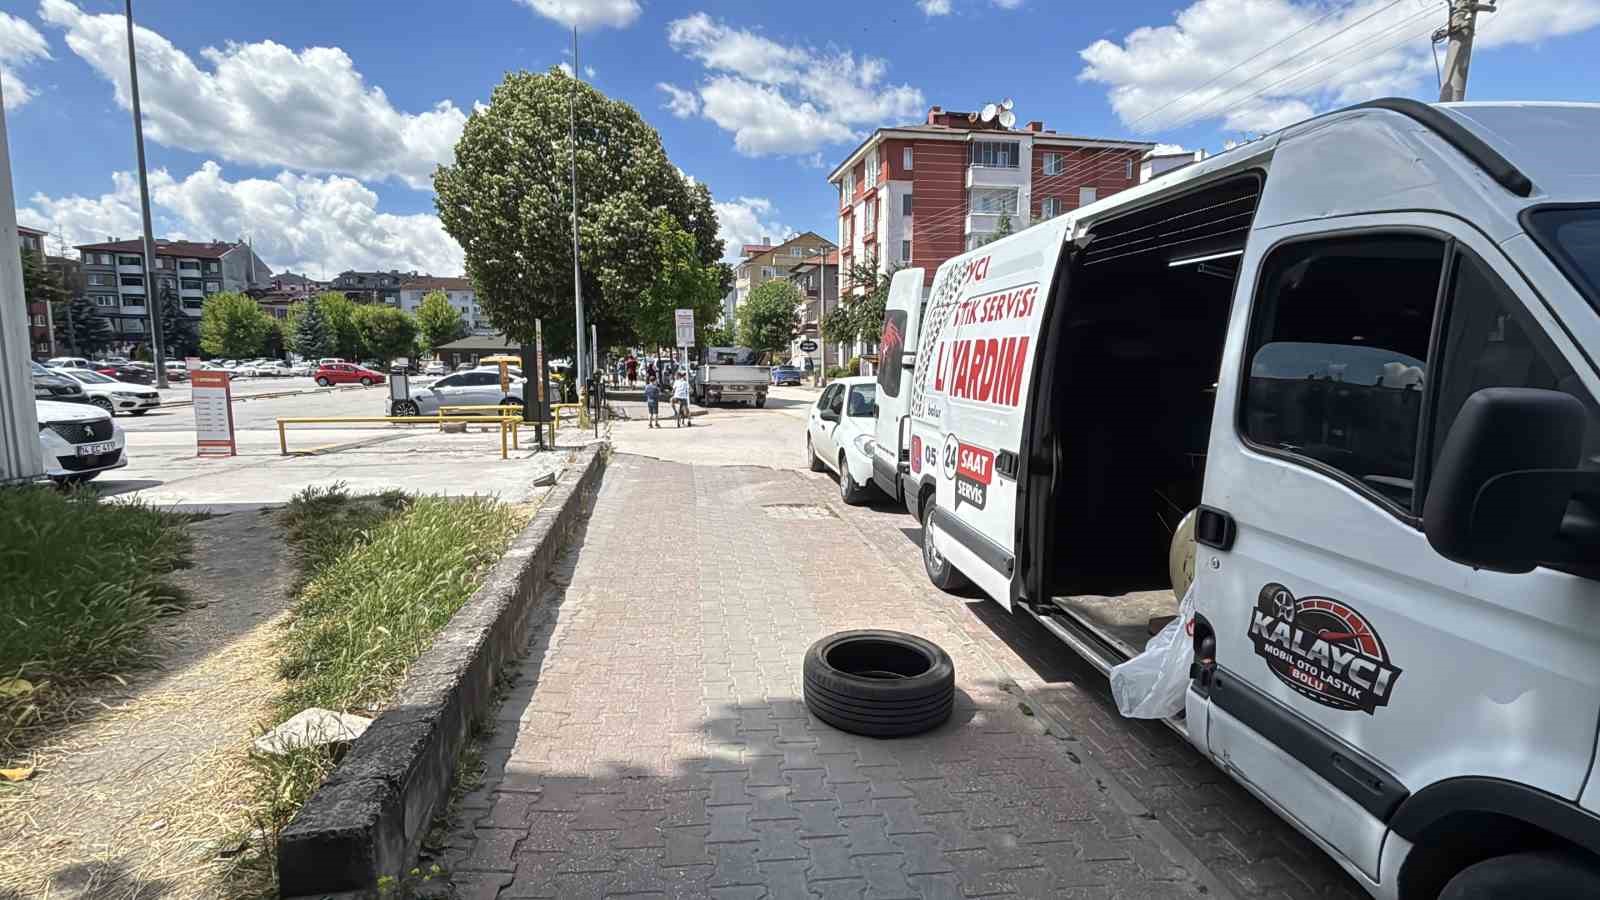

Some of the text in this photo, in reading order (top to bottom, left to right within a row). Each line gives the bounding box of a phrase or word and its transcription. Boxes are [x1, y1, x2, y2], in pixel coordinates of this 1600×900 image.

[949, 336, 1030, 407] YARDIM
[945, 443, 989, 476] 24 SAAT
[1251, 610, 1393, 697] KALAYCI
[1297, 659, 1318, 677] OTO
[1292, 667, 1325, 691] BOLU
